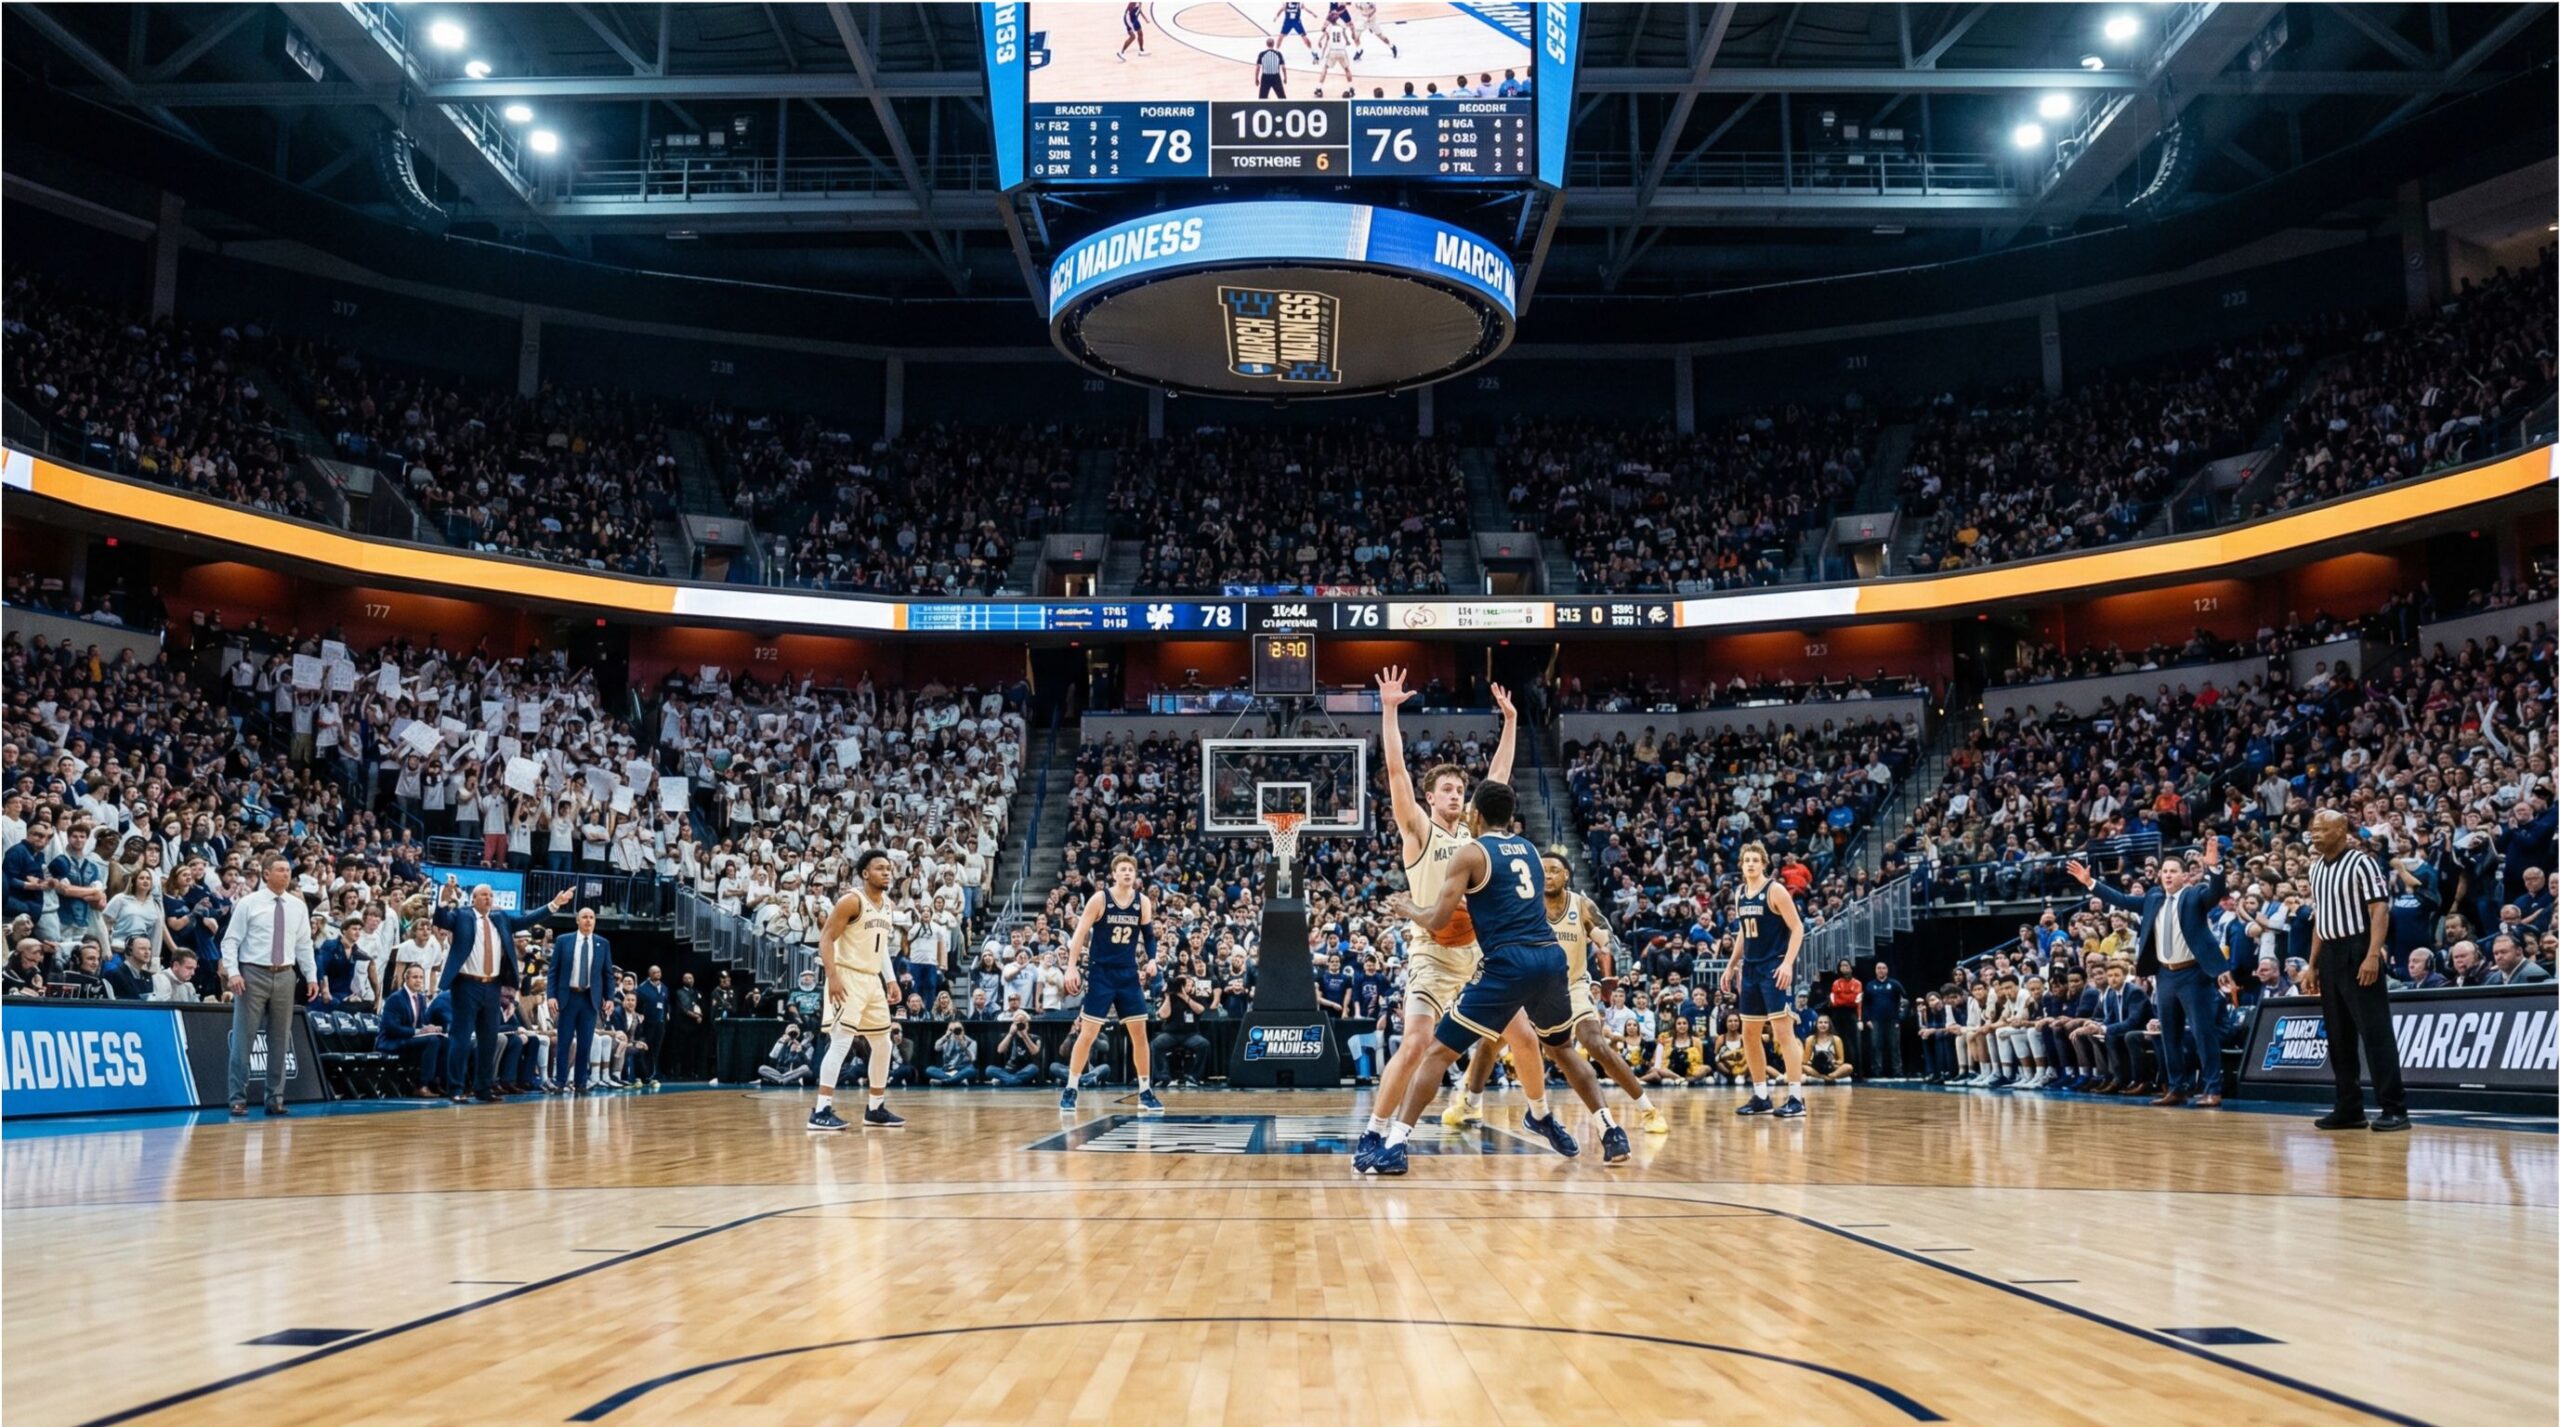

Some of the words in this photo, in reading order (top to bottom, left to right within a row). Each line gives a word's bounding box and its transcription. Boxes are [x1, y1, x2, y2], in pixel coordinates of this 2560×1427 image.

[1089, 136, 1097, 146] 7
[1141, 129, 1193, 164] 78
[1366, 128, 1418, 162] 76
[1316, 153, 1329, 170] 6
[1076, 217, 1203, 284] MADNESS
[1435, 231, 1504, 291] MARCH
[1279, 293, 1320, 361] MADNESS
[1235, 317, 1277, 364] MARCH
[365, 603, 390, 618] 177
[2193, 597, 2218, 612] 121
[1200, 606, 1232, 627] 78
[1348, 605, 1379, 627] 76
[1591, 607, 1603, 624] 0
[1510, 858, 1536, 899] 3
[874, 932, 880, 953] 1
[1111, 926, 1132, 944] 32
[1266, 1042, 1322, 1054] MADNESS
